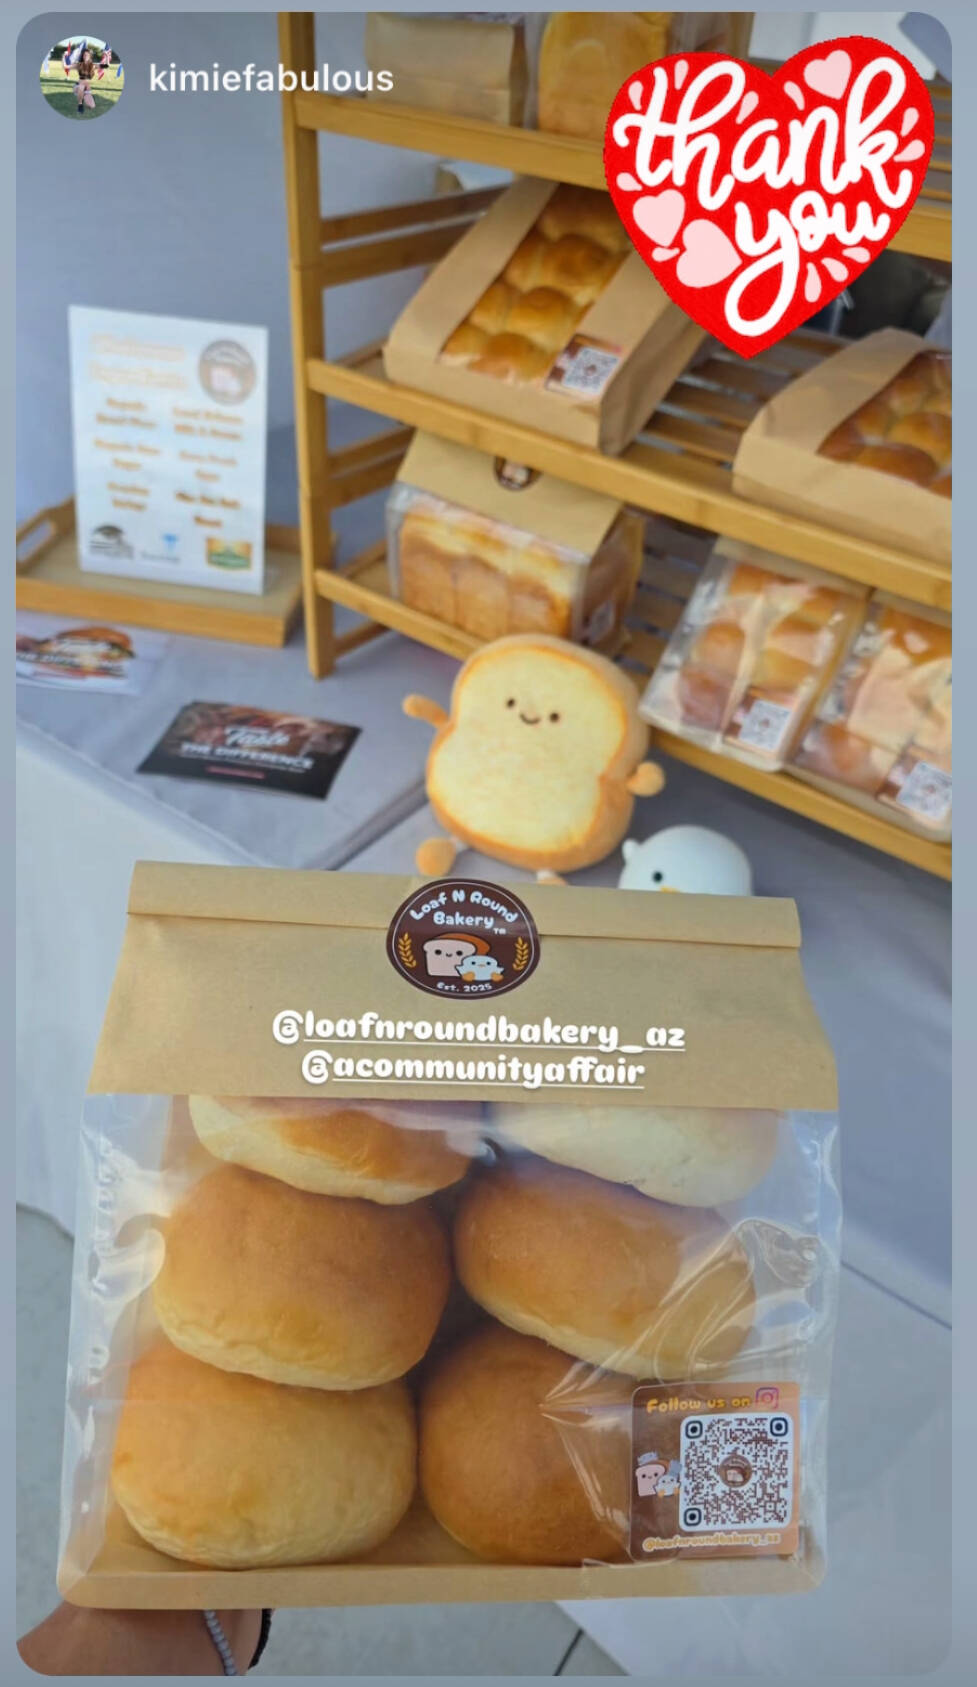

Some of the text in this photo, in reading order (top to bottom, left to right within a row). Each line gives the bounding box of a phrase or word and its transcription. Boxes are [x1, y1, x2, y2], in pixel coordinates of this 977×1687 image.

[214, 746, 314, 770] DIFFERENCE
[410, 890, 518, 922] Loaf N Round
[433, 912, 494, 929] Bakery
[463, 983, 492, 993] 2025
[646, 1396, 751, 1414] Follow us on
